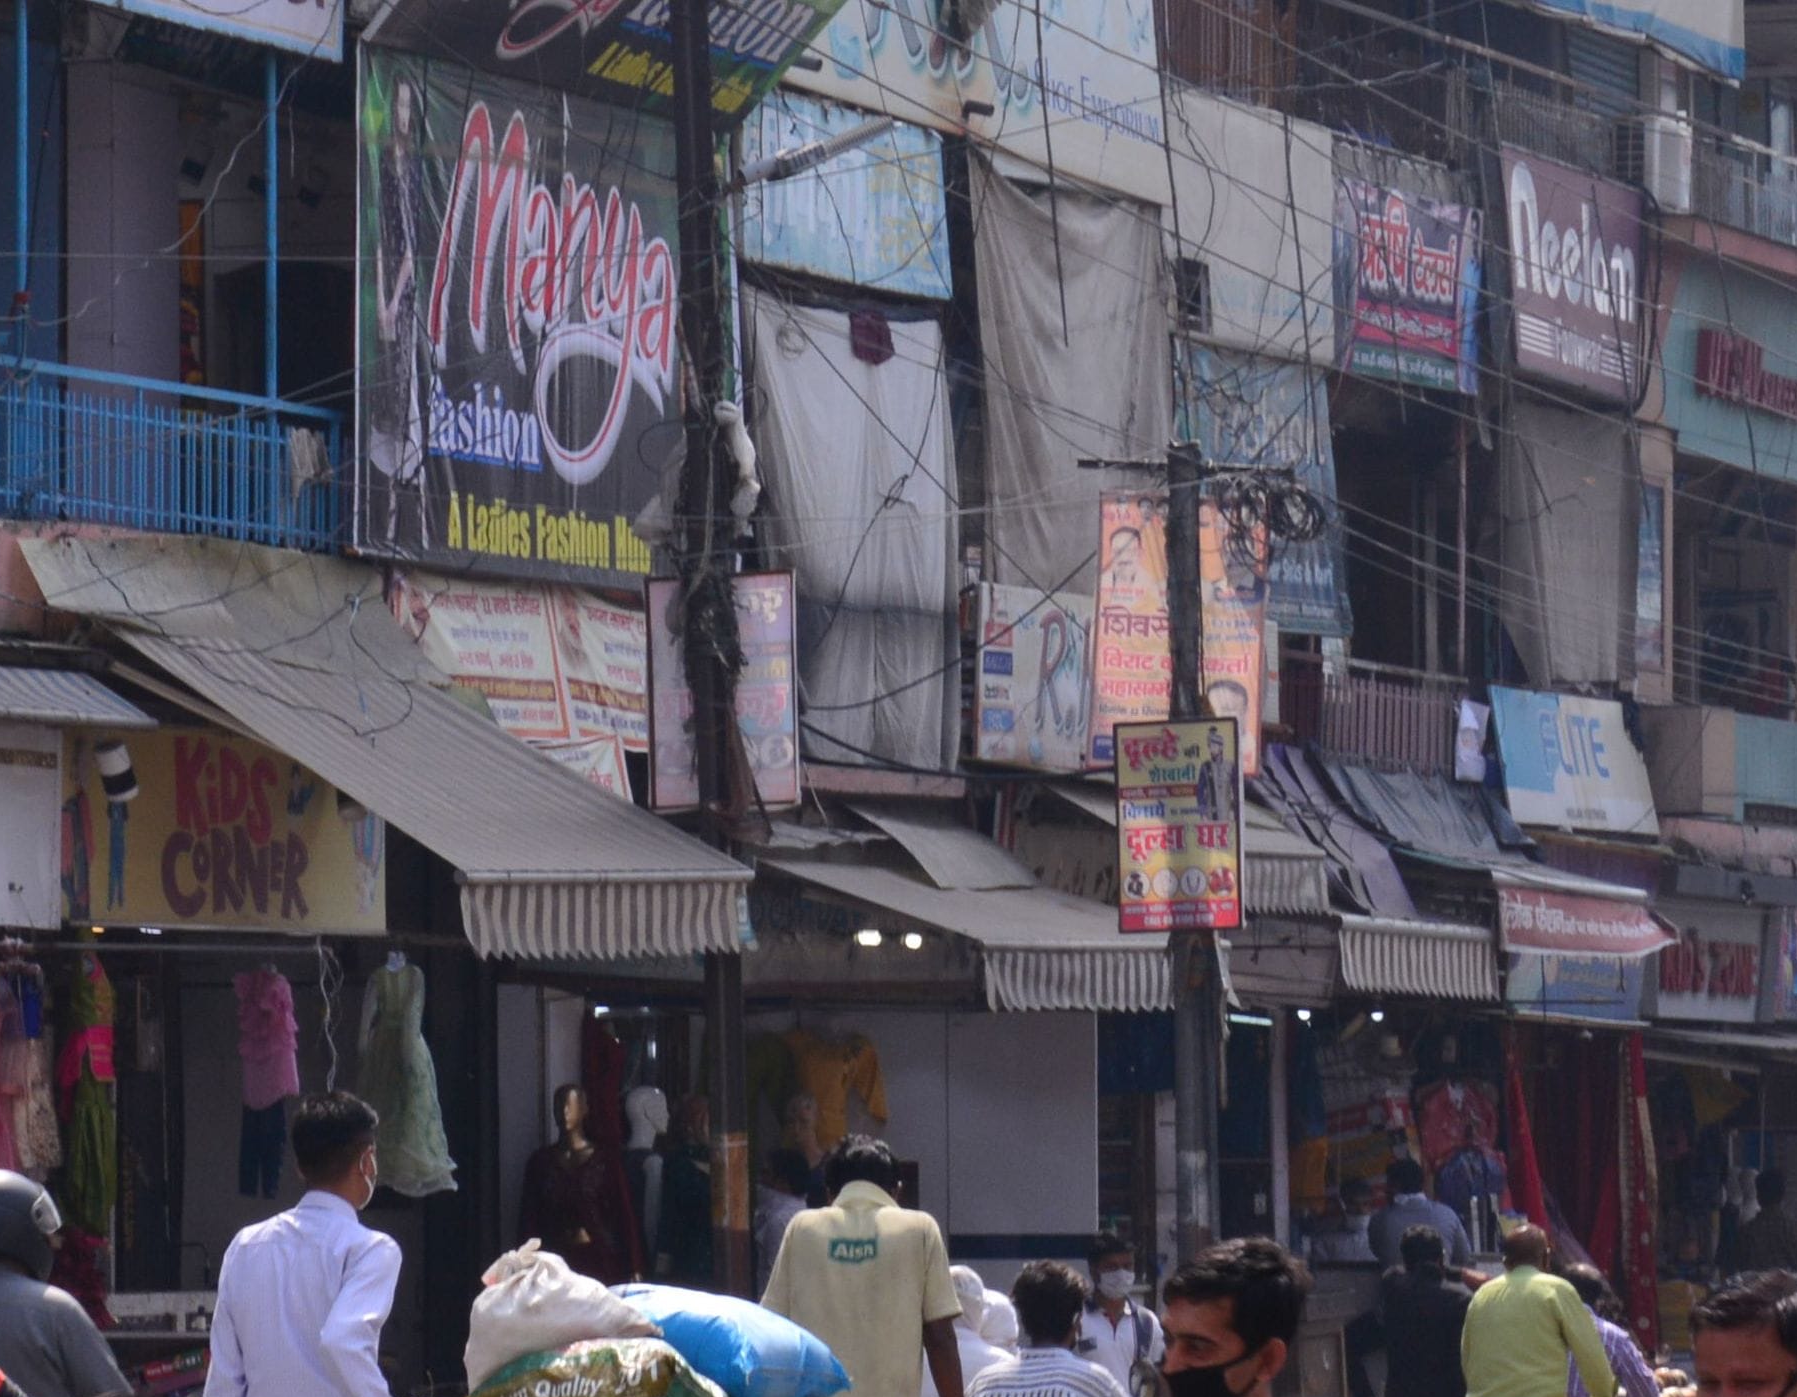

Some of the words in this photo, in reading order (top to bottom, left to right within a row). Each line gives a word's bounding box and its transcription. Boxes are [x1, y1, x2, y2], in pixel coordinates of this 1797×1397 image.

[428, 101, 678, 486] Manya
[448, 491, 462, 549] A
[467, 493, 531, 560] Ladies
[536, 503, 611, 571] Fashion
